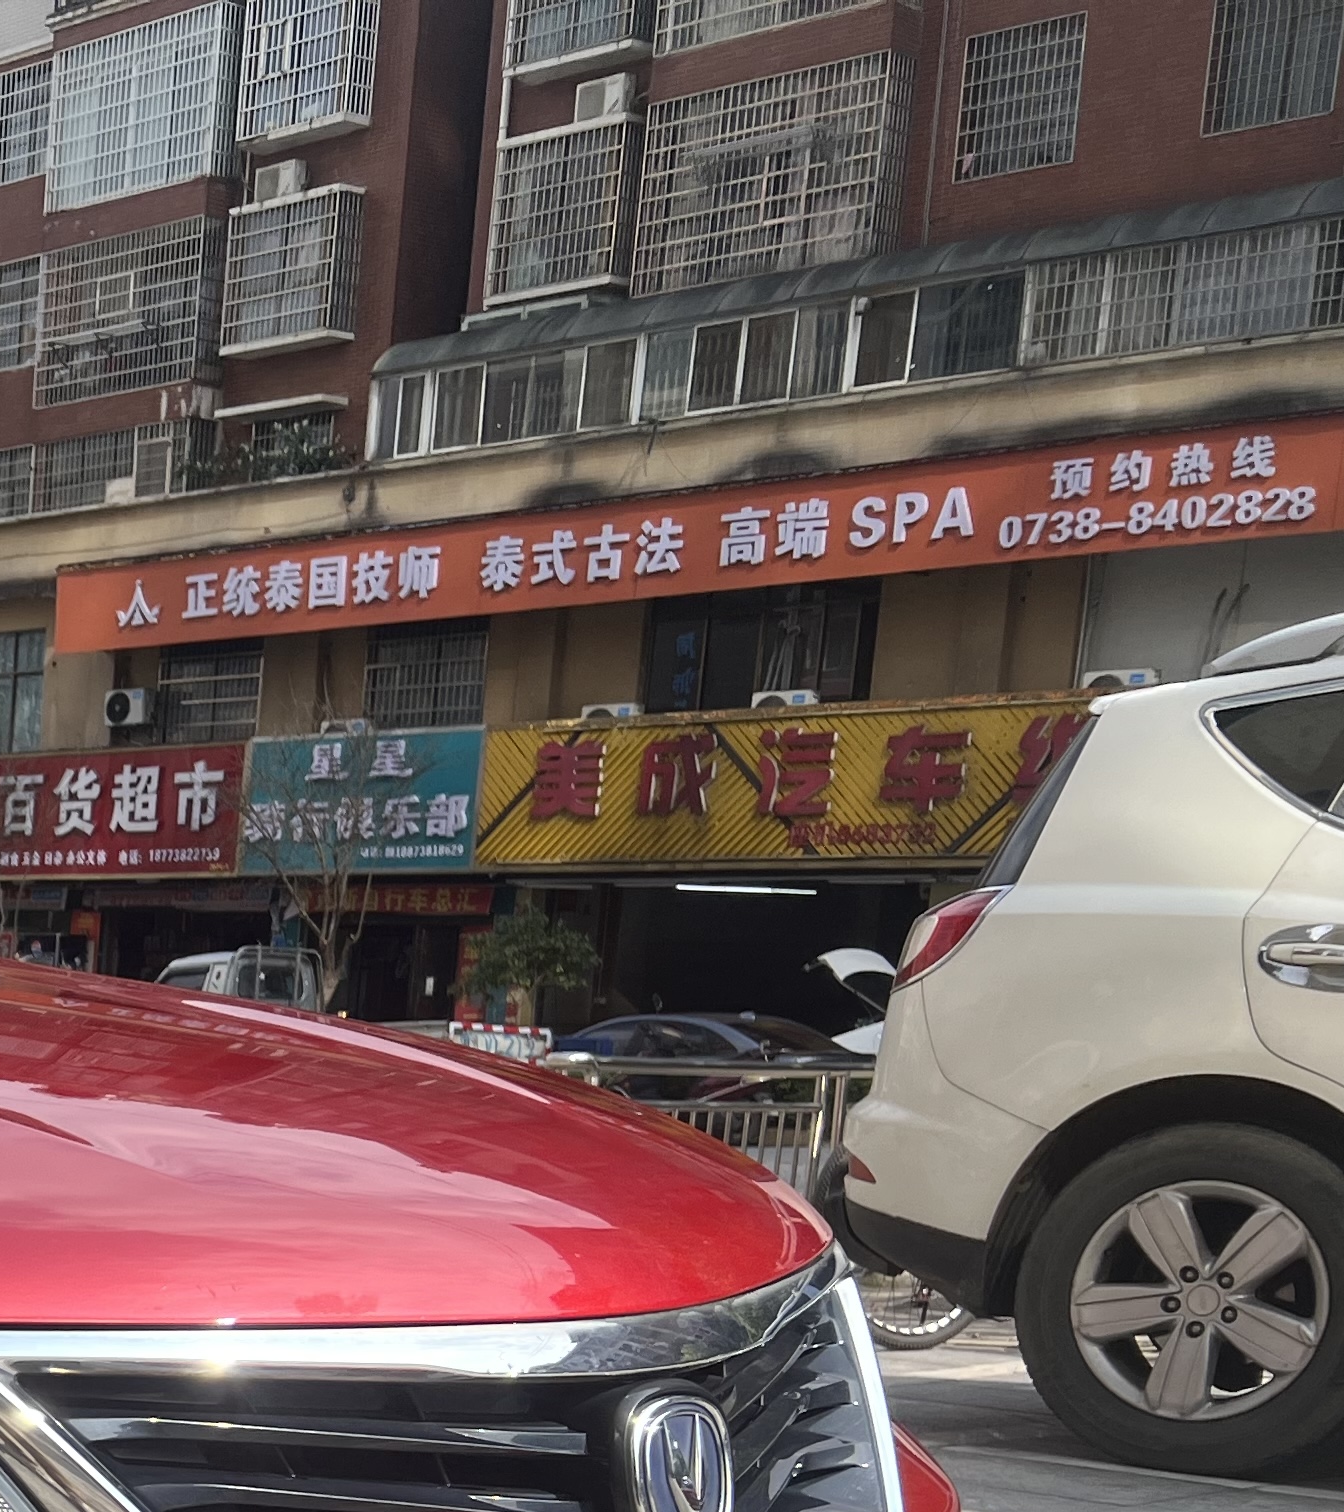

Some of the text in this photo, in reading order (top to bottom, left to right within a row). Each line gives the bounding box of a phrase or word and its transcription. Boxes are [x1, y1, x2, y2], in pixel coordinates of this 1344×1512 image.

[1050, 435, 1277, 499] 预约热线
[998, 486, 1316, 549] 0738-8402828
[181, 485, 976, 620] 正统泰国技师 泰式古法 高端 SPA
